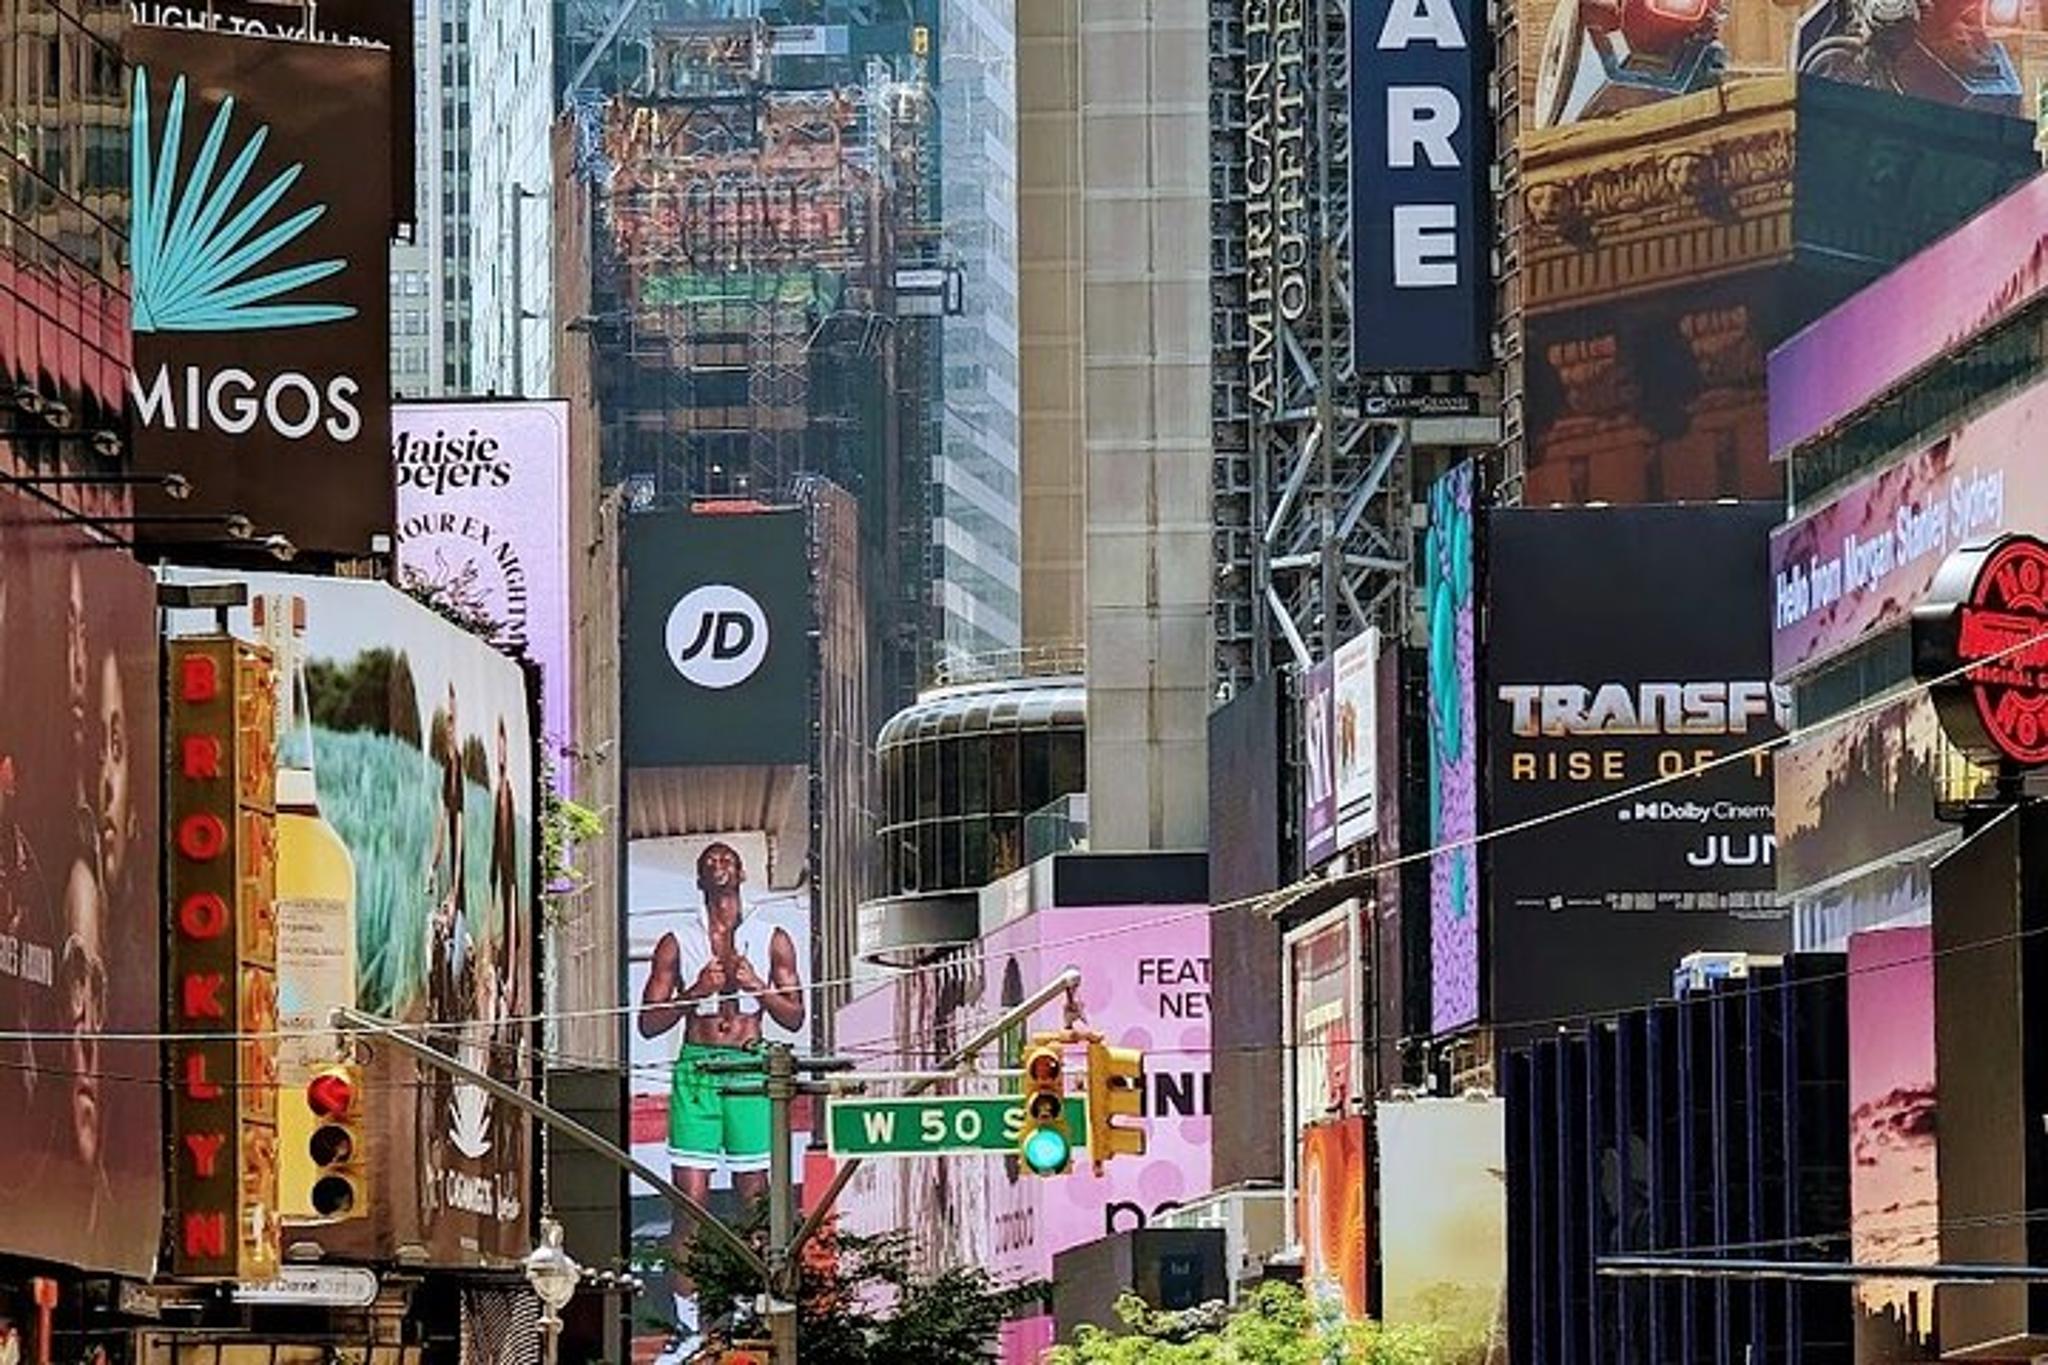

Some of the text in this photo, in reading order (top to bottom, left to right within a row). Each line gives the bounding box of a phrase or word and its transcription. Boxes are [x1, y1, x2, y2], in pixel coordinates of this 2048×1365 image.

[1376, 0, 1468, 288] ARE
[1246, 60, 1275, 411] AMERICAN
[130, 362, 361, 442] MIGOS
[1777, 466, 2004, 629] Hello from Morgan Stanley Sydney
[682, 611, 755, 661] JD
[1512, 752, 1626, 781] RISE
[1660, 801, 1710, 823] Dolby
[177, 653, 226, 1259] BROOKLYN
[1138, 958, 1212, 985] FEAT
[1159, 991, 1213, 1019] NE
[863, 1110, 895, 1144] W
[921, 1108, 982, 1142] 50
